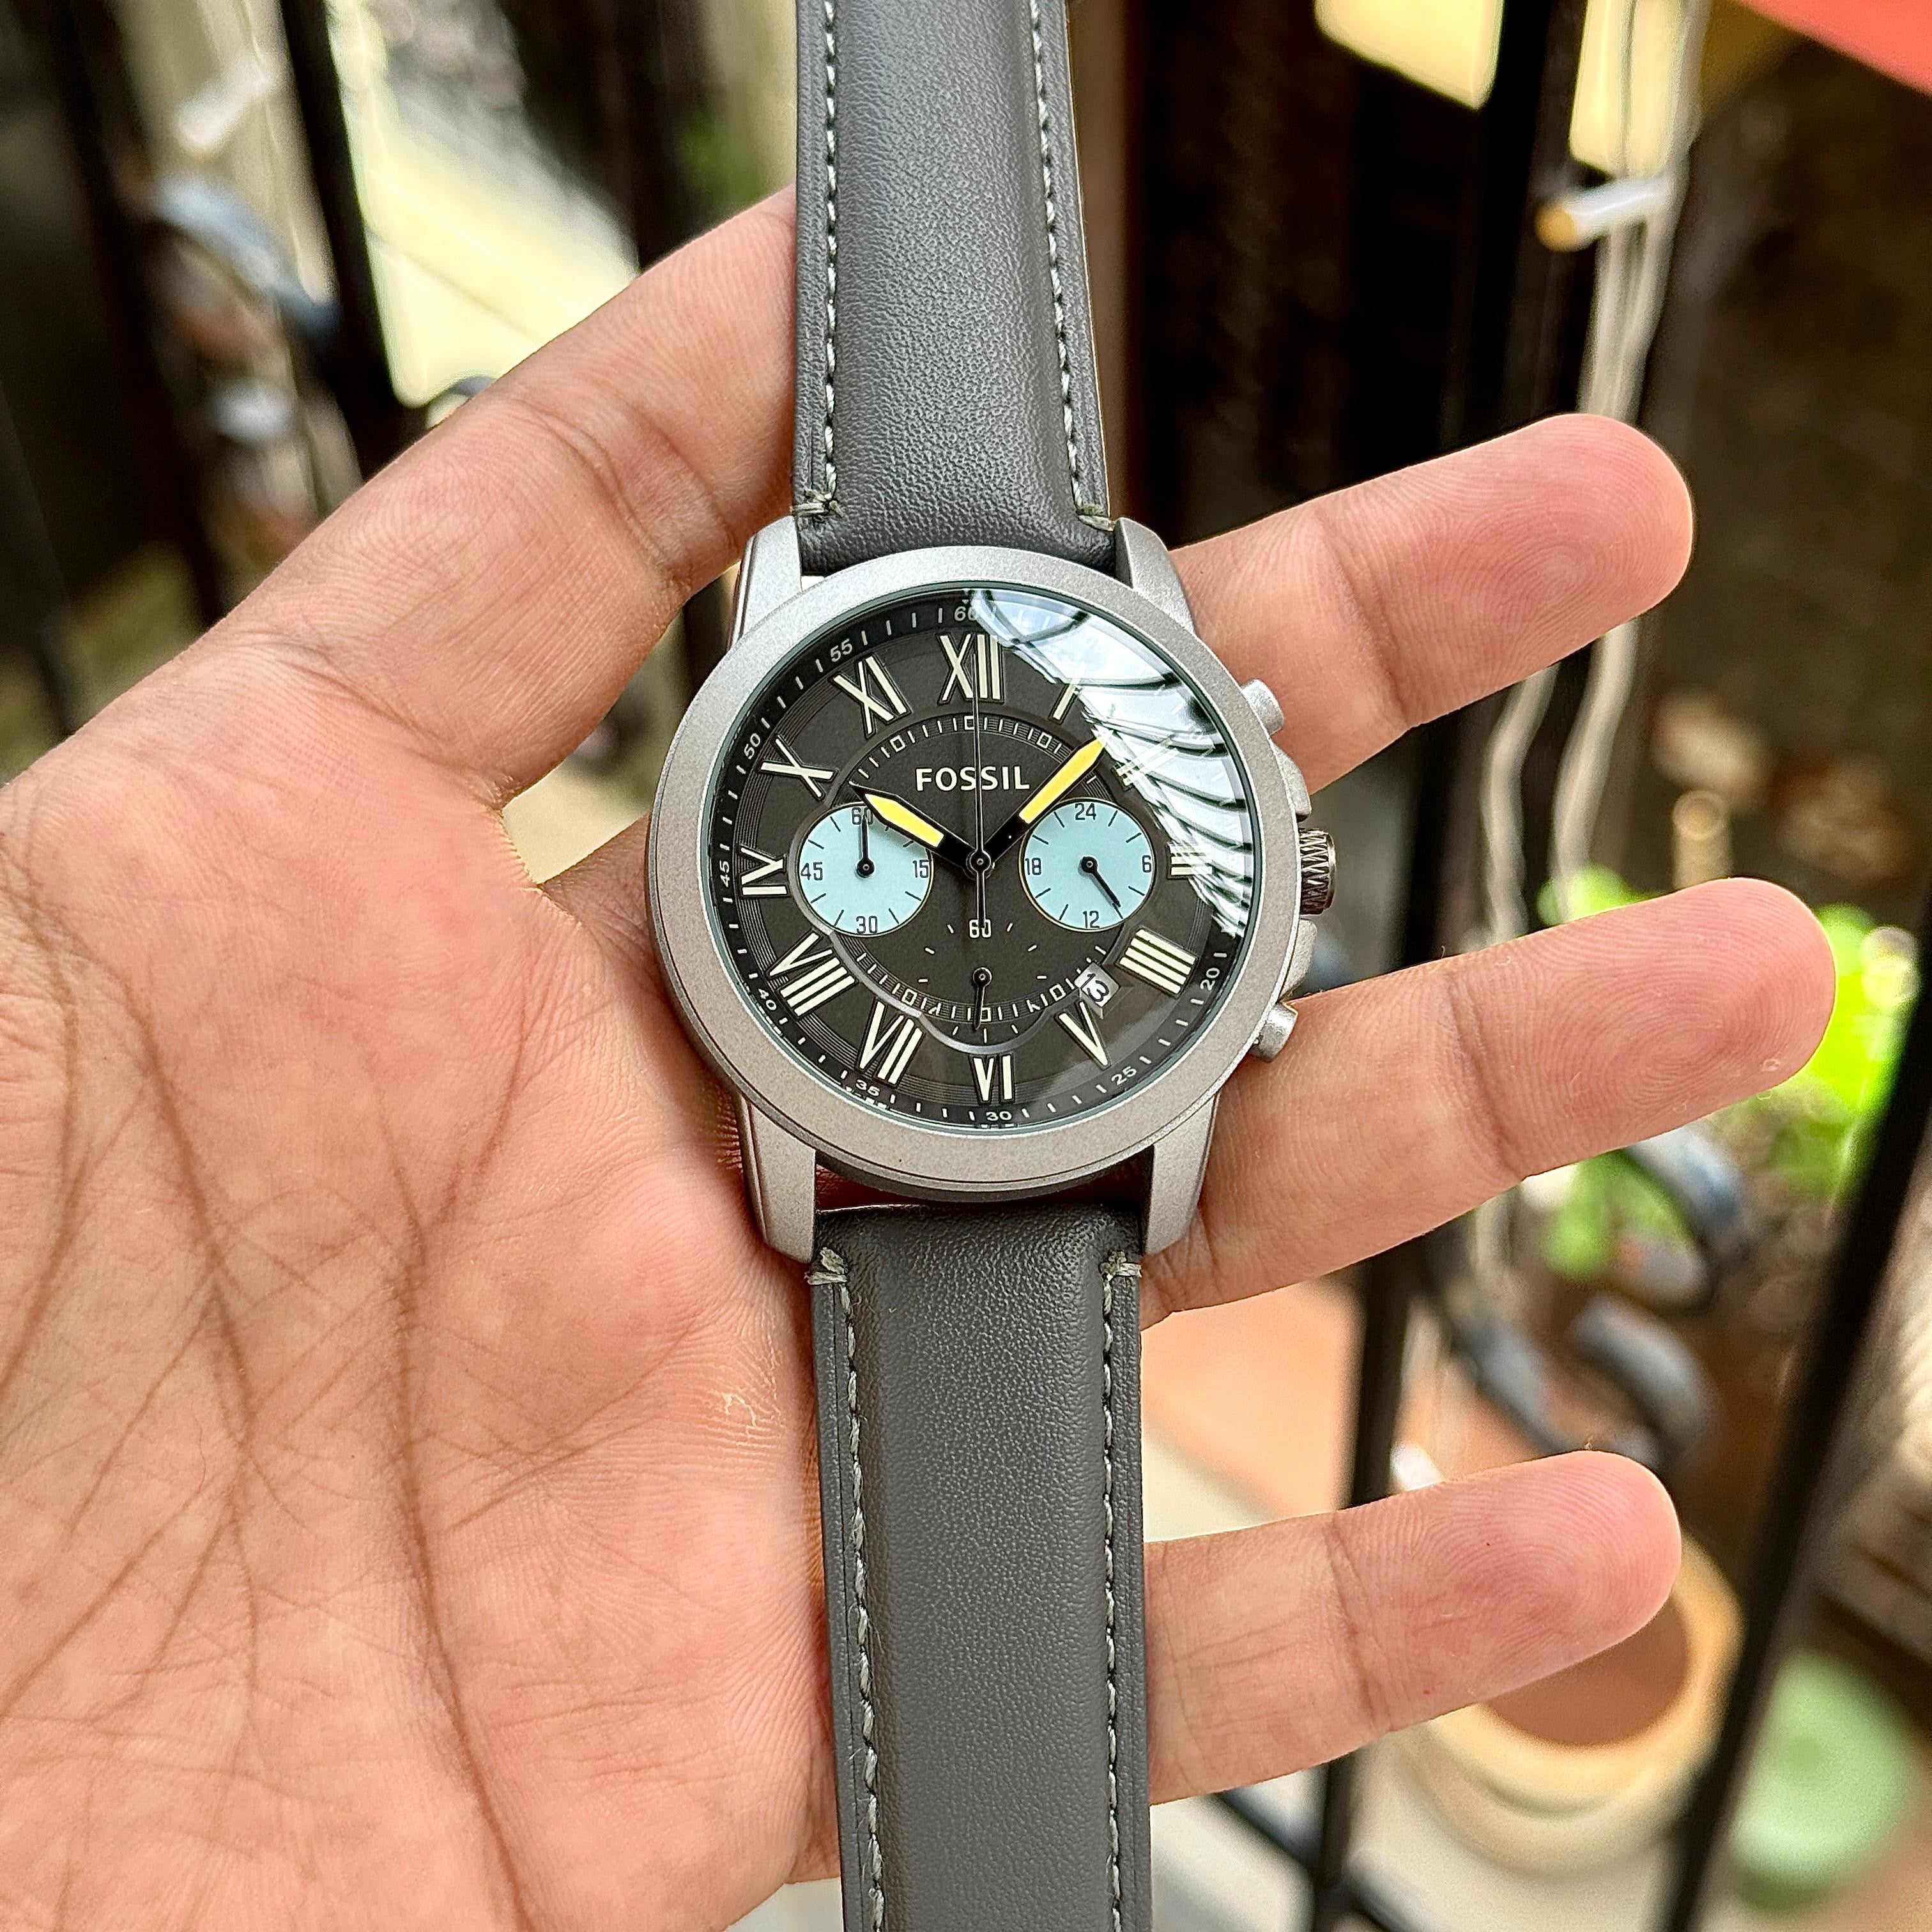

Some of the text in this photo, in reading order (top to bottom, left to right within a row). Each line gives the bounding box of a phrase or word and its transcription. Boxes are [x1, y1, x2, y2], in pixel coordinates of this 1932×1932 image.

[831, 639, 853, 662] 55
[939, 634, 1001, 701] XII
[833, 656, 907, 734] XI
[744, 733, 761, 759] 50
[760, 738, 833, 797] X
[916, 766, 1030, 791] FOSSIL
[852, 808, 873, 825] 60
[1075, 802, 1096, 820] 24
[719, 860, 730, 887] 45
[801, 861, 823, 880] 45
[912, 859, 929, 878] 15
[1025, 857, 1041, 875] 18
[1142, 855, 1152, 873] 6
[856, 916, 878, 933] 30
[969, 919, 991, 938] 60
[1082, 910, 1100, 928] 12
[1119, 929, 1197, 994] IIII
[769, 933, 855, 1016] VIII
[1200, 967, 1220, 991] 20
[1080, 972, 1110, 1002] 13
[758, 988, 777, 1010] 40
[859, 1002, 923, 1084] VII
[1059, 1000, 1108, 1066] V
[855, 1078, 880, 1096] 35
[973, 1055, 1013, 1101] VI
[1111, 1066, 1137, 1085] 25
[985, 1111, 1012, 1121] 30
